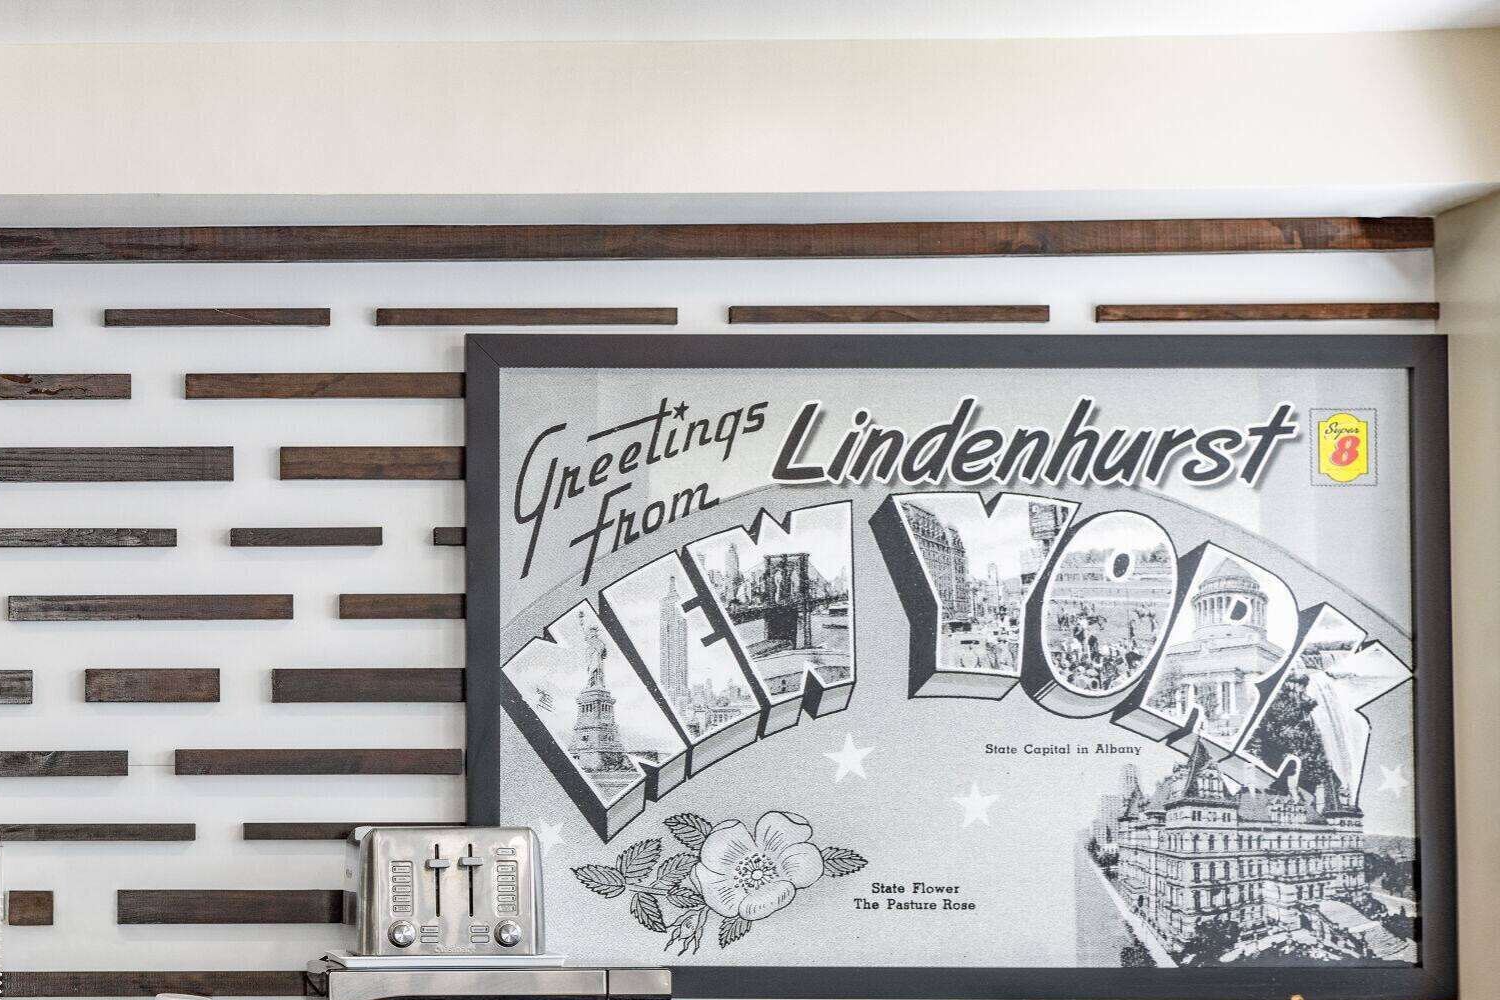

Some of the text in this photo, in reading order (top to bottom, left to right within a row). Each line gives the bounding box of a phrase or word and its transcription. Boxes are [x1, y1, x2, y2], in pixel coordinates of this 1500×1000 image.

[770, 397, 1300, 486] Lindenhurst
[1324, 421, 1360, 440] Super
[1329, 435, 1361, 467] 8
[513, 397, 769, 579] Greetings
[499, 490, 1415, 845] NEW YORK
[985, 743, 1142, 757] State Capital in Albany
[871, 882, 961, 894] State Flower
[853, 898, 977, 911] The Pasture Rose
